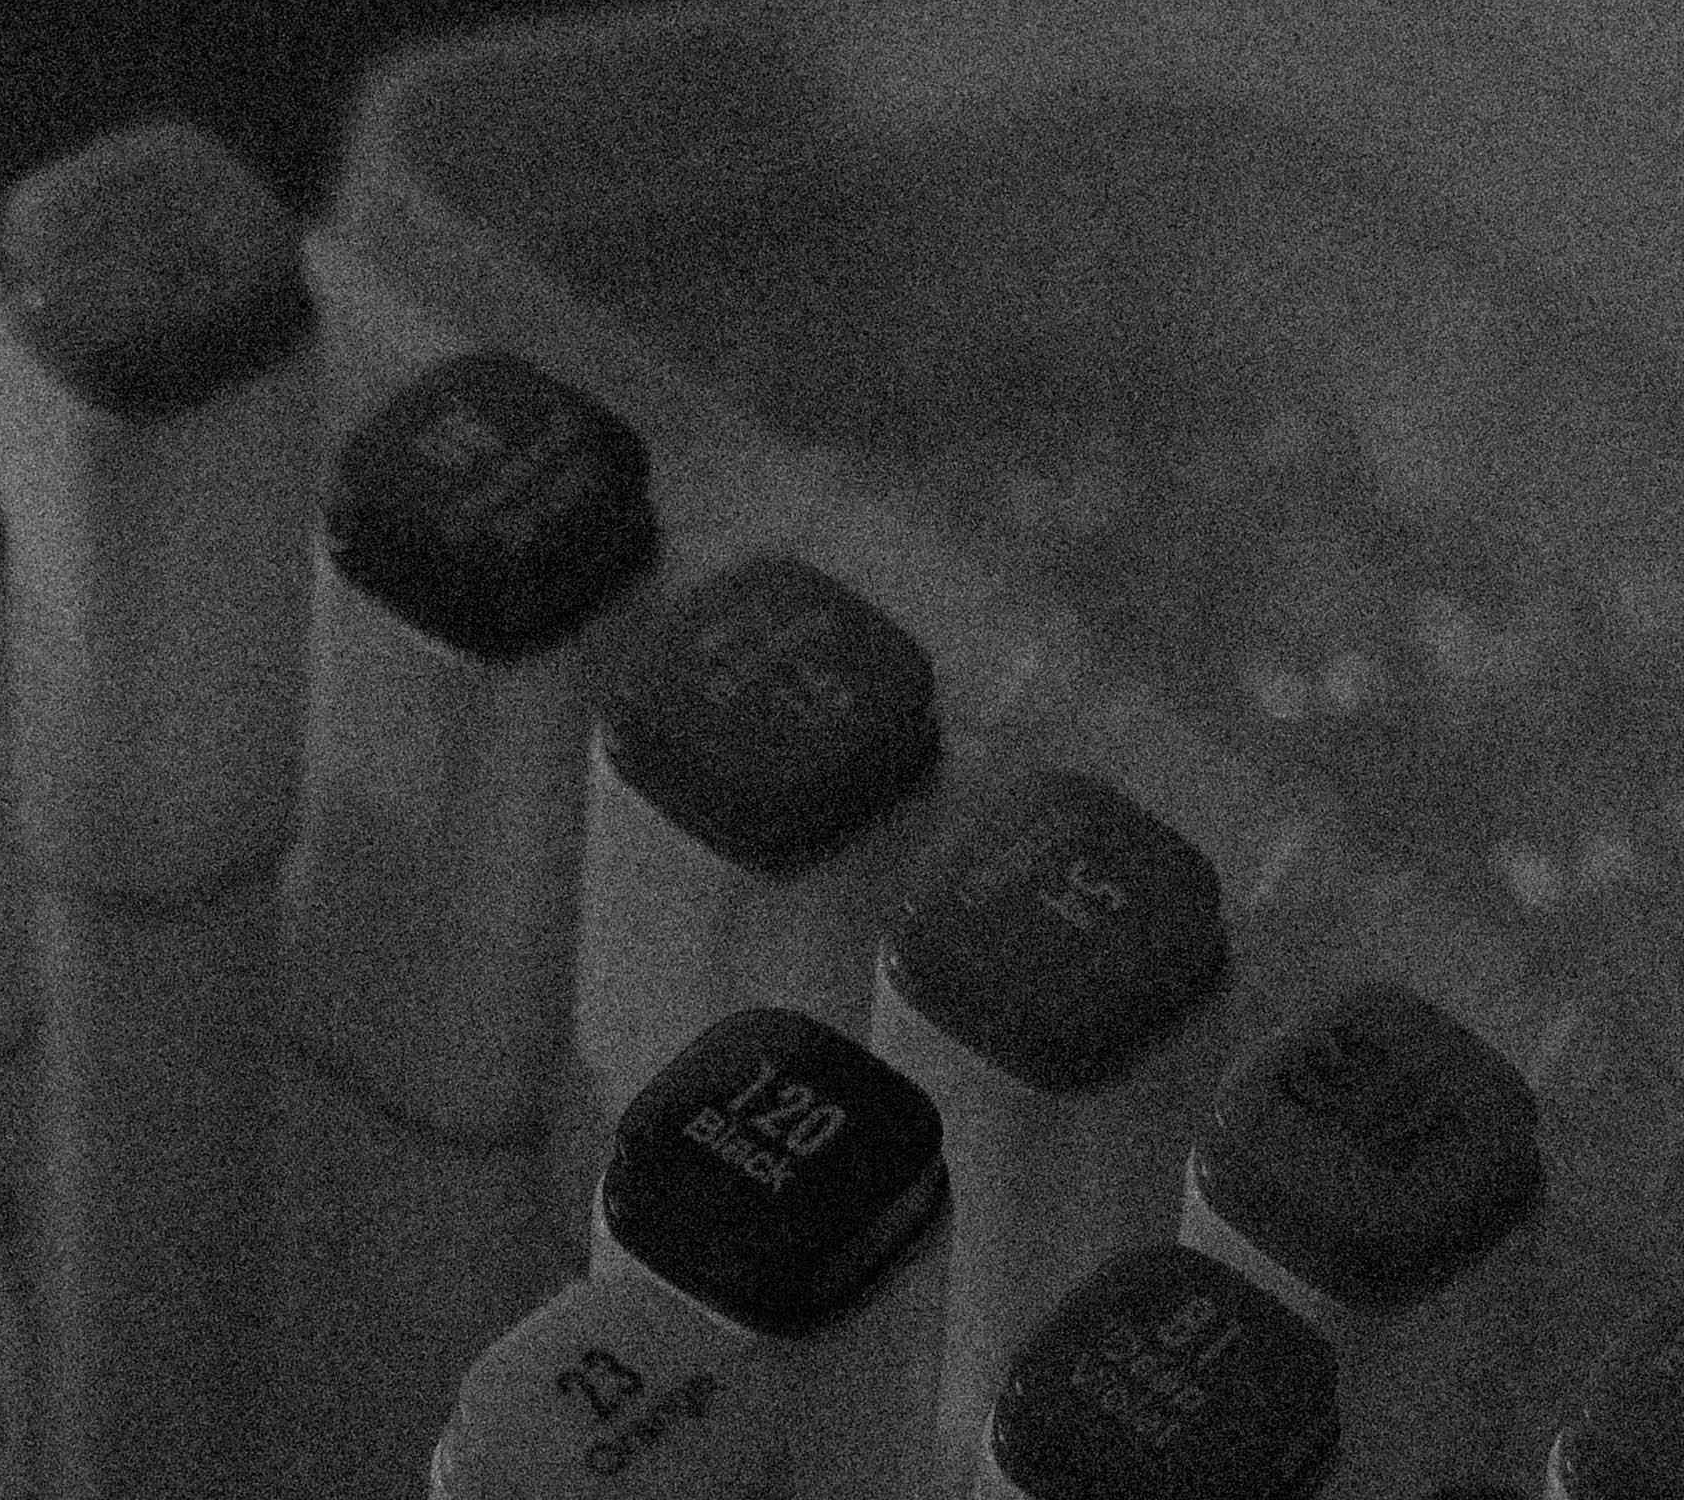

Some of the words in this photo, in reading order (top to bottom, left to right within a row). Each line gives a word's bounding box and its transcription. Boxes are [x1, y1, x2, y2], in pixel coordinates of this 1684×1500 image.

[682, 1104, 798, 1197] Black
[729, 1056, 849, 1159] 120
[1155, 1293, 1244, 1373] 81
[555, 1347, 645, 1423] 23
[584, 1370, 721, 1478] Orange
